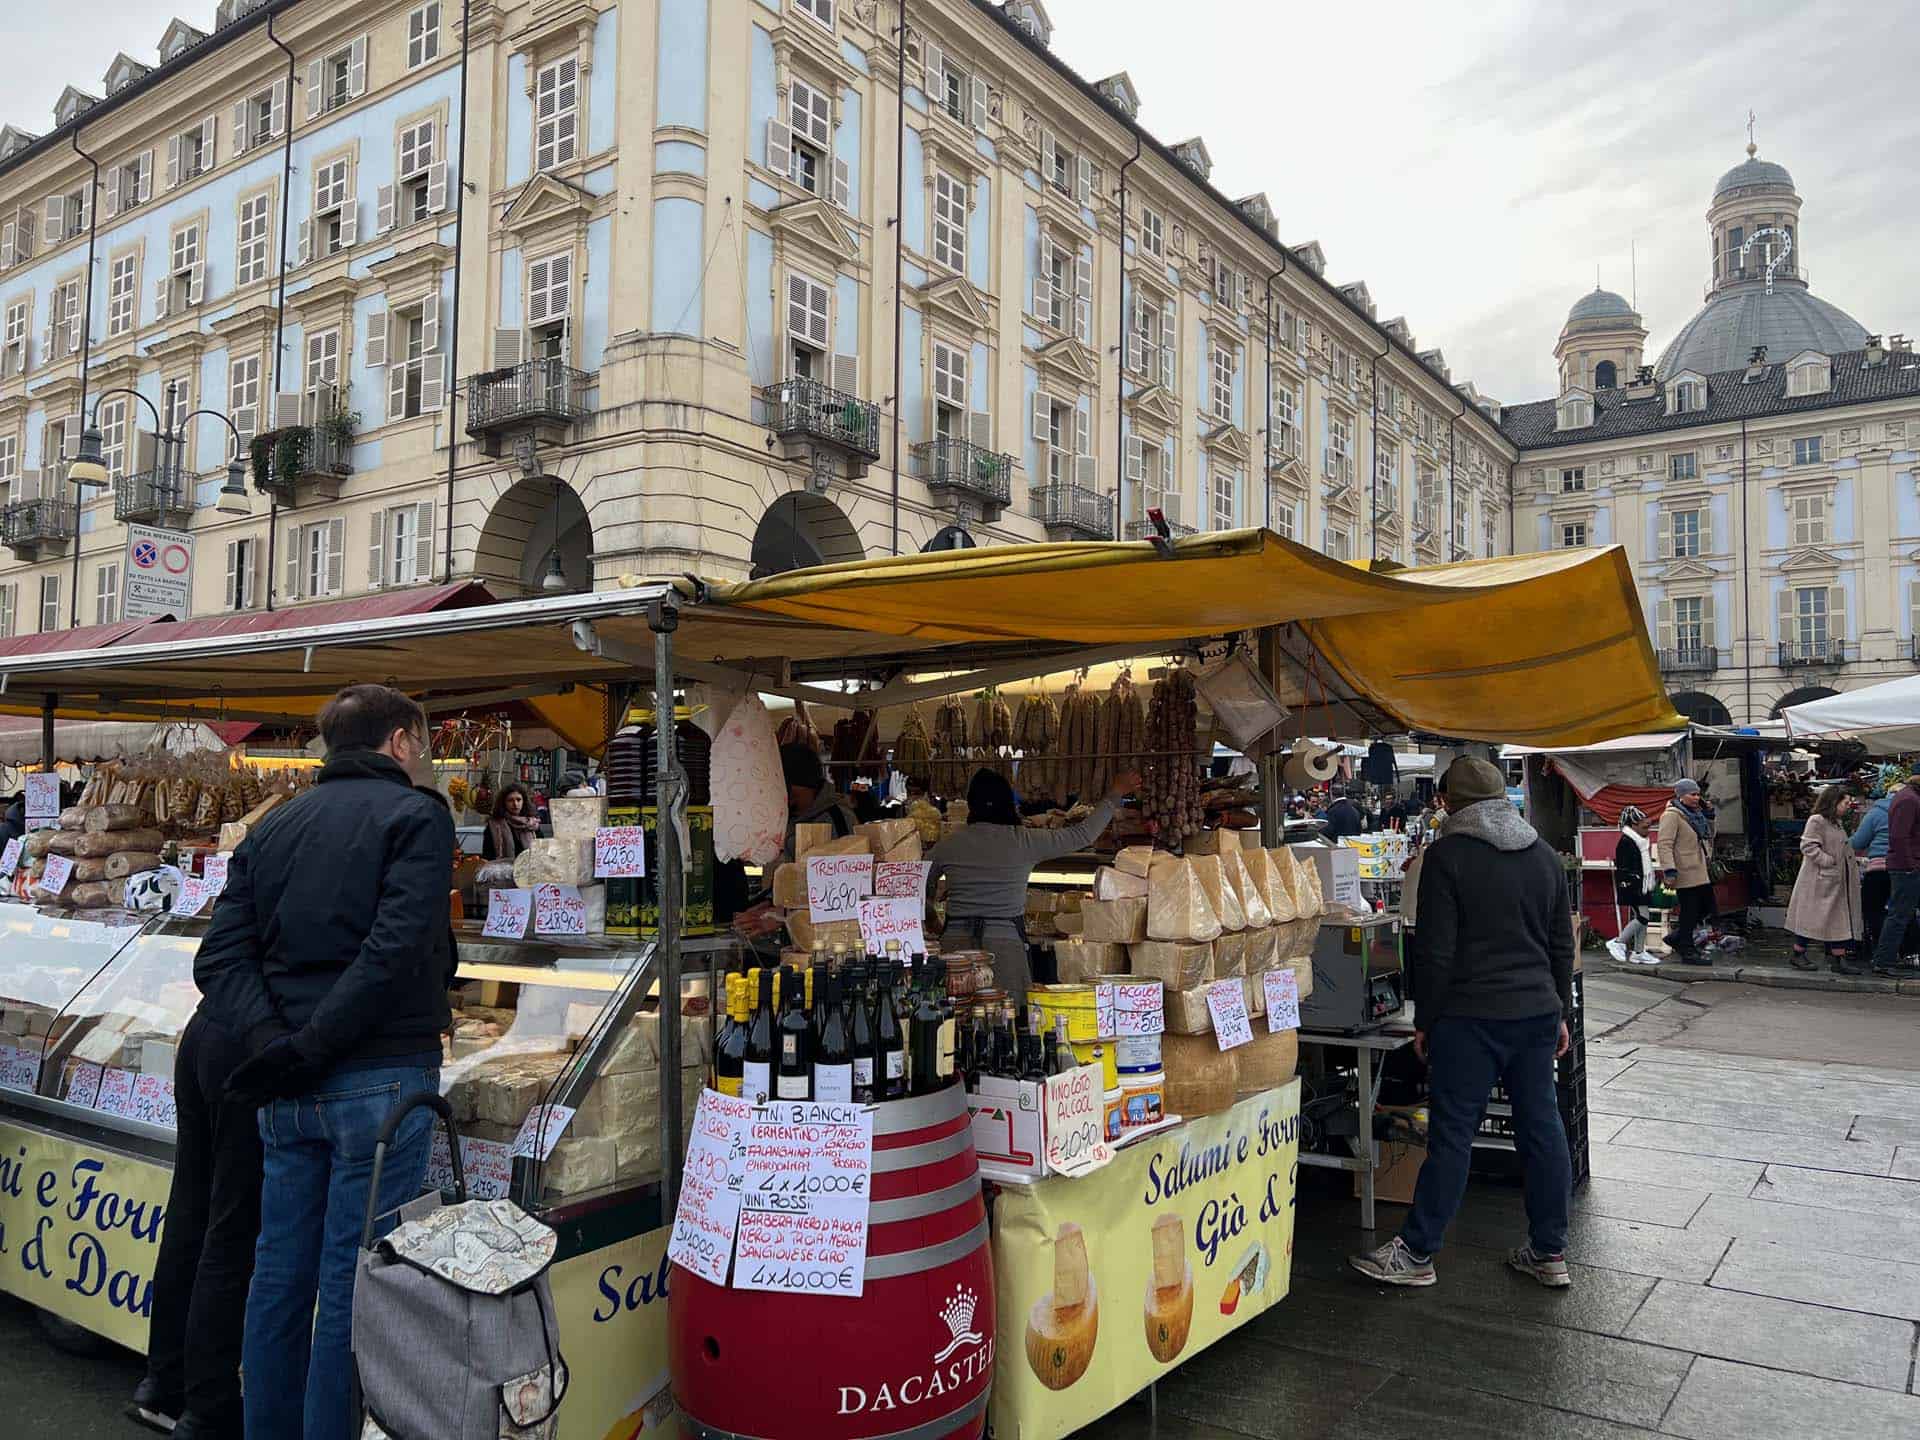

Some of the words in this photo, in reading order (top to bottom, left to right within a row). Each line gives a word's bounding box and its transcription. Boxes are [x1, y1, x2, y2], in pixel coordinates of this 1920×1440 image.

[133, 529, 152, 537] AREA
[36, 1170, 58, 1208] e
[1144, 1129, 1233, 1206] Salumi
[1236, 1135, 1249, 1164] e
[1195, 1192, 1249, 1267] Giò
